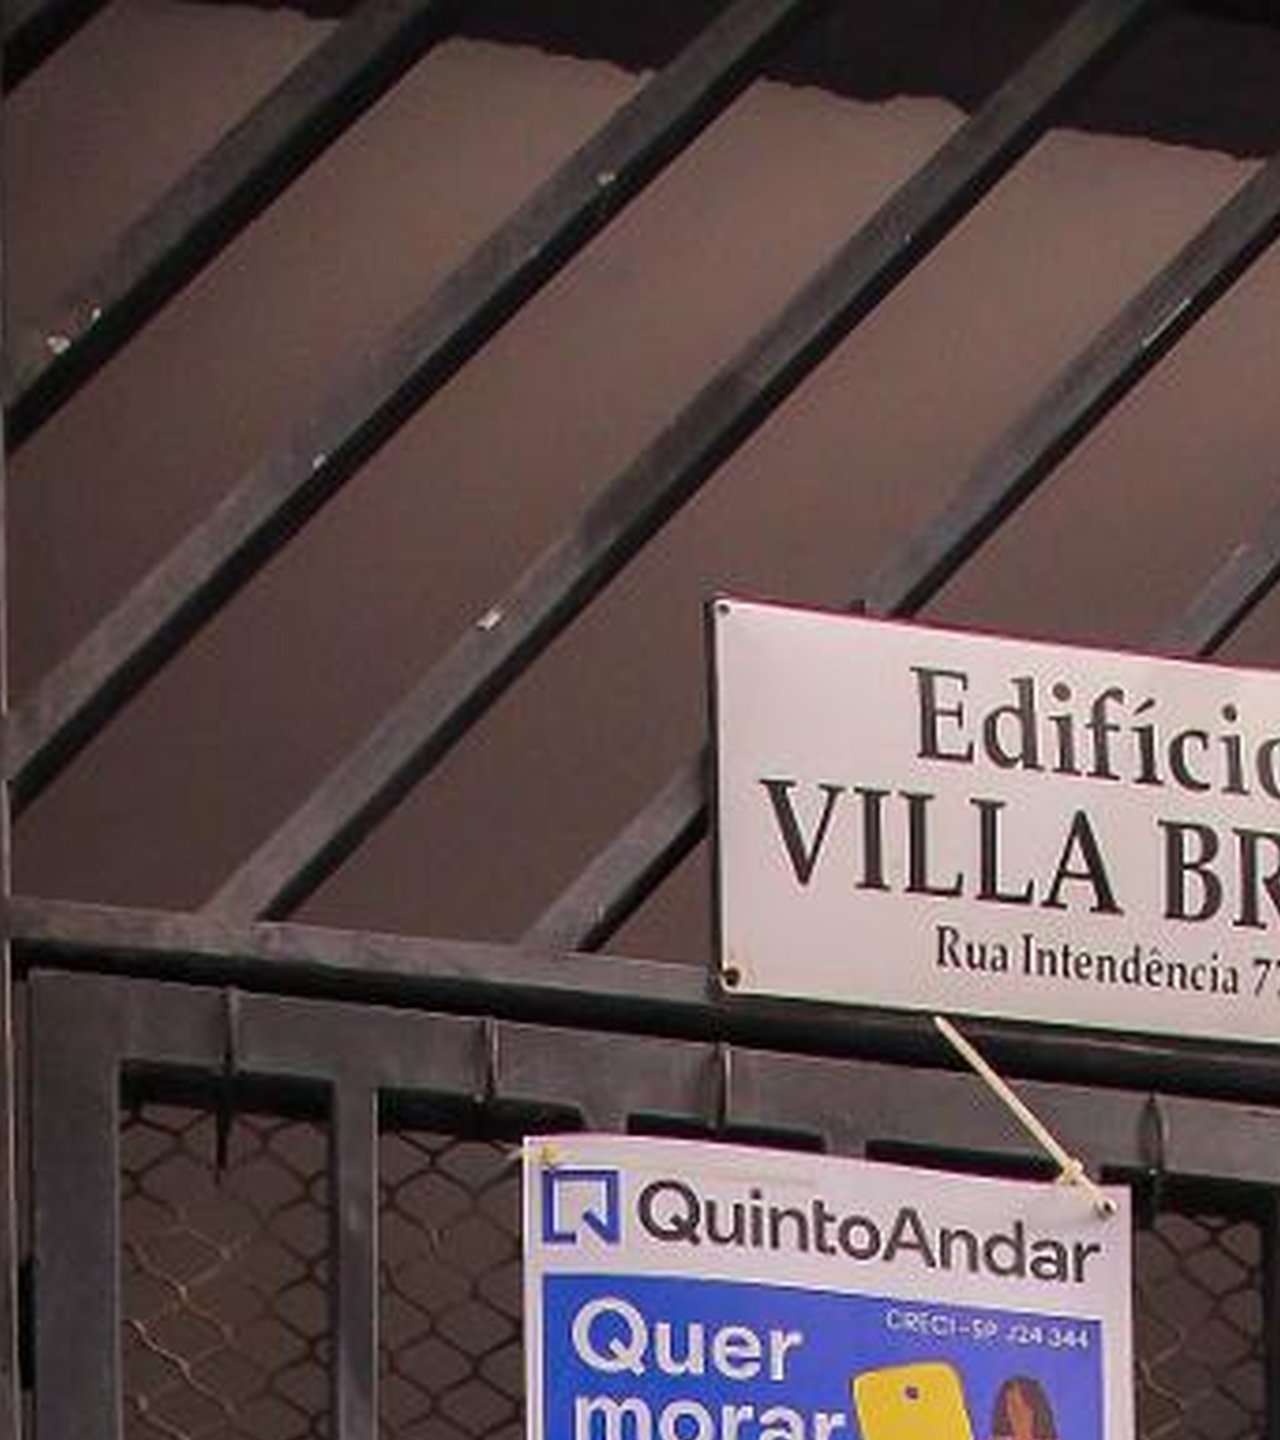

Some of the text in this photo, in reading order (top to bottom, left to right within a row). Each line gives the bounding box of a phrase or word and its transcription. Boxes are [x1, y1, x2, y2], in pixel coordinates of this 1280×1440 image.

[759, 778, 1124, 916] VILLA
[935, 925, 1010, 973] Rua
[1020, 934, 1240, 996] Intendência
[637, 1180, 1101, 1284] QuintoAndar
[571, 1297, 804, 1383] Quer
